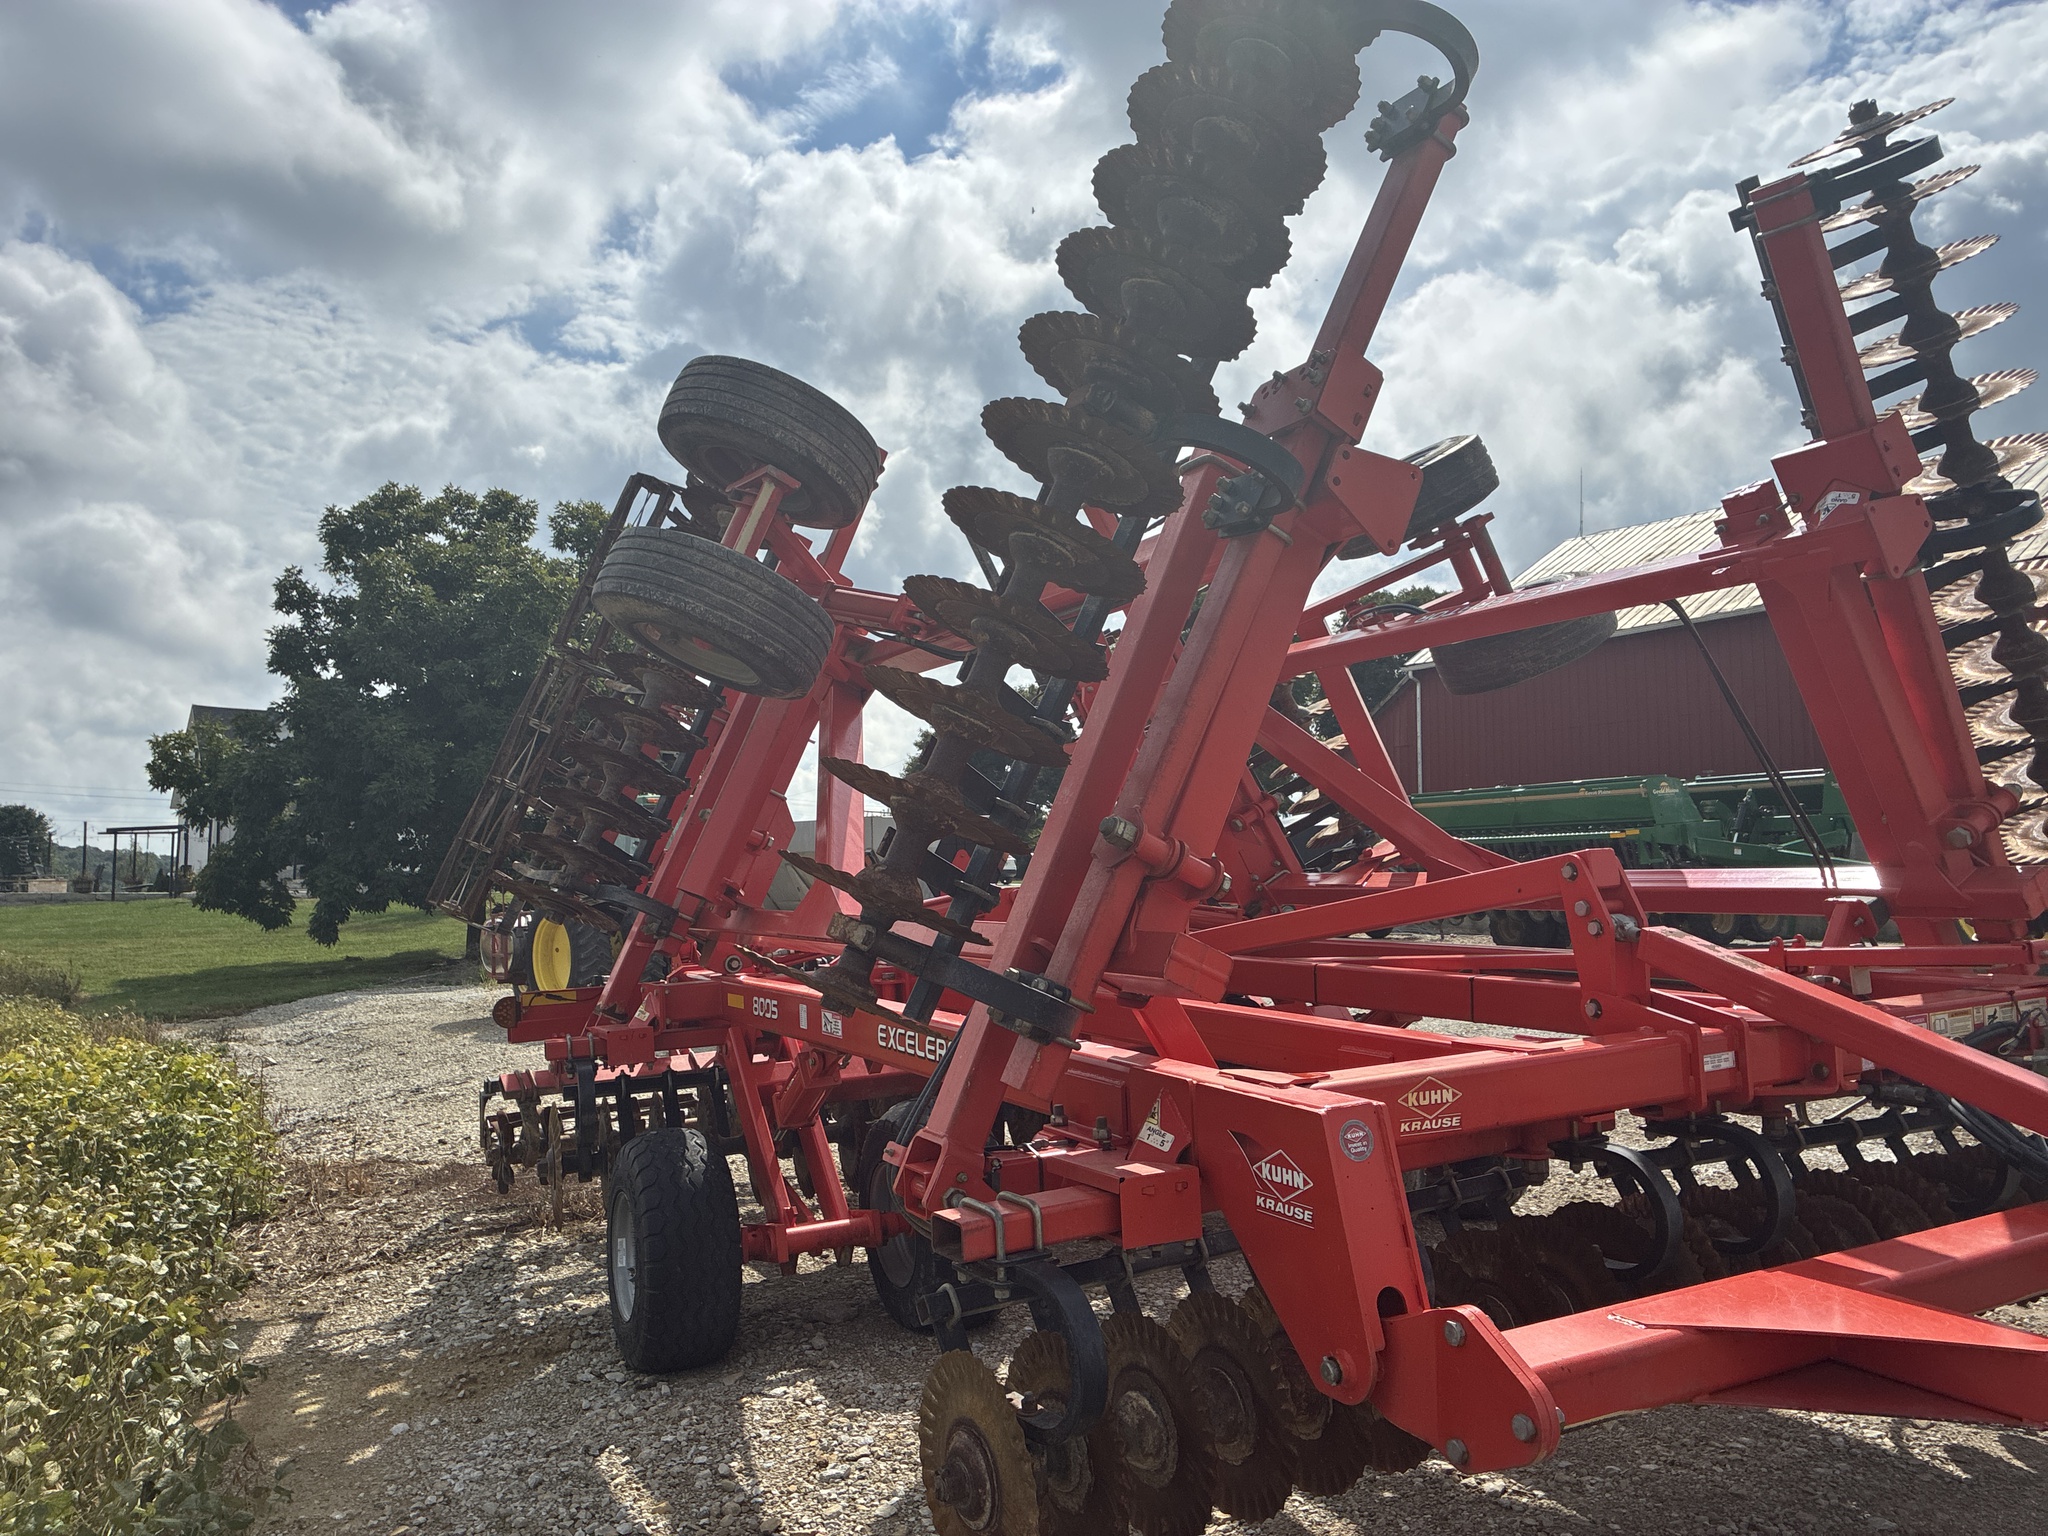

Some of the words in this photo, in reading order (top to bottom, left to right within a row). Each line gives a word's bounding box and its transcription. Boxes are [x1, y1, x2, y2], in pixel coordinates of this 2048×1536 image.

[752, 996, 778, 1020] 8005
[877, 1024, 953, 1061] EXCELER
[1407, 1087, 1453, 1107] KUHN
[1146, 1125, 1168, 1139] ANGLE
[1400, 1116, 1462, 1133] KRAUSE
[1347, 1131, 1364, 1139] KUHN
[1350, 1146, 1367, 1154] Quality
[1260, 1162, 1305, 1190] KUHN
[1256, 1195, 1314, 1224] KRAUSE
